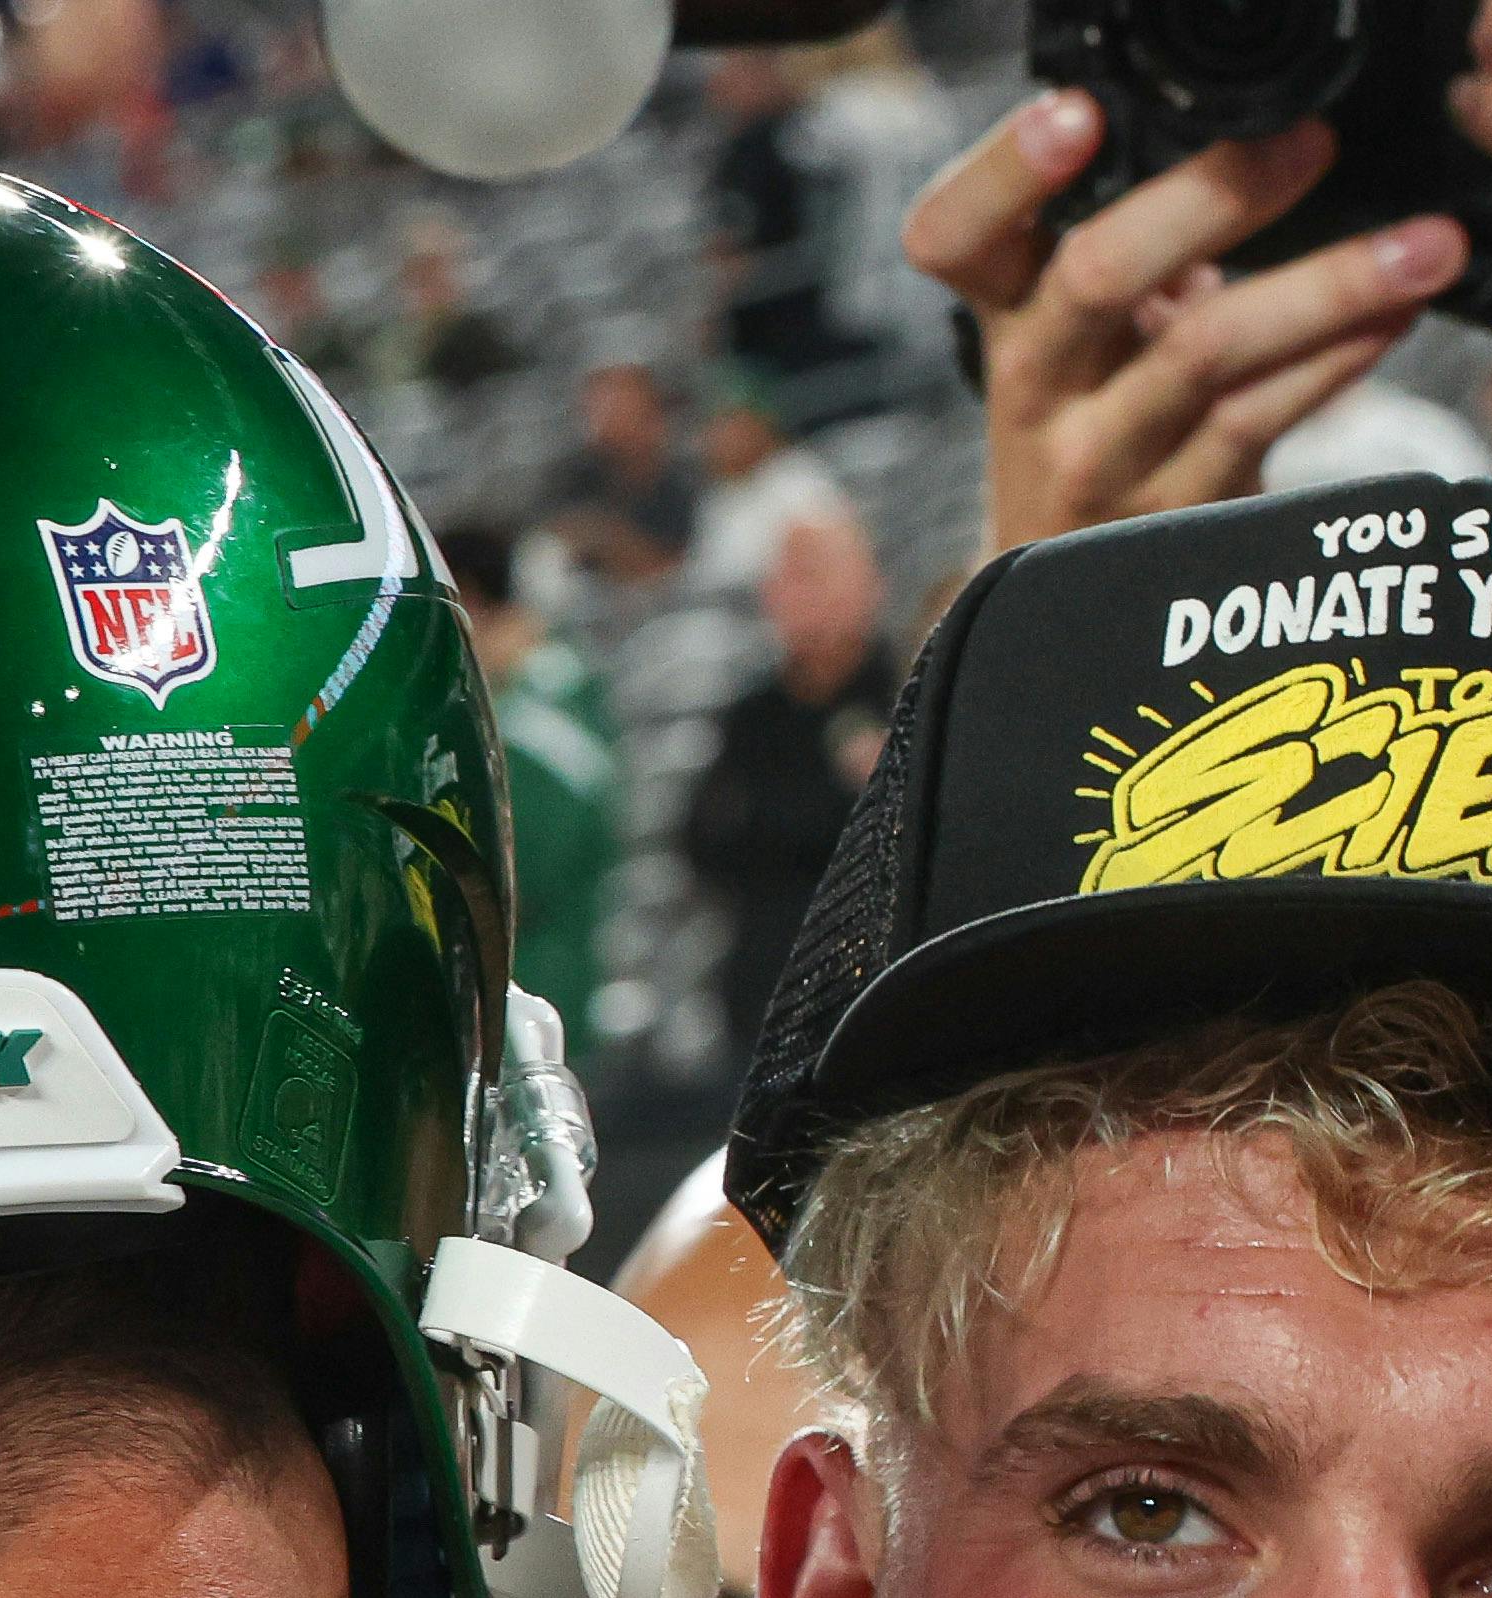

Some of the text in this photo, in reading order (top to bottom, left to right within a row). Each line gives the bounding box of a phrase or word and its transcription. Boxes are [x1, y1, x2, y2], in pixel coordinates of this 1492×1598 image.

[1314, 507, 1427, 558] YOU
[81, 587, 198, 661] NFL
[1162, 565, 1440, 668] DONATE
[99, 731, 234, 751] WARNING
